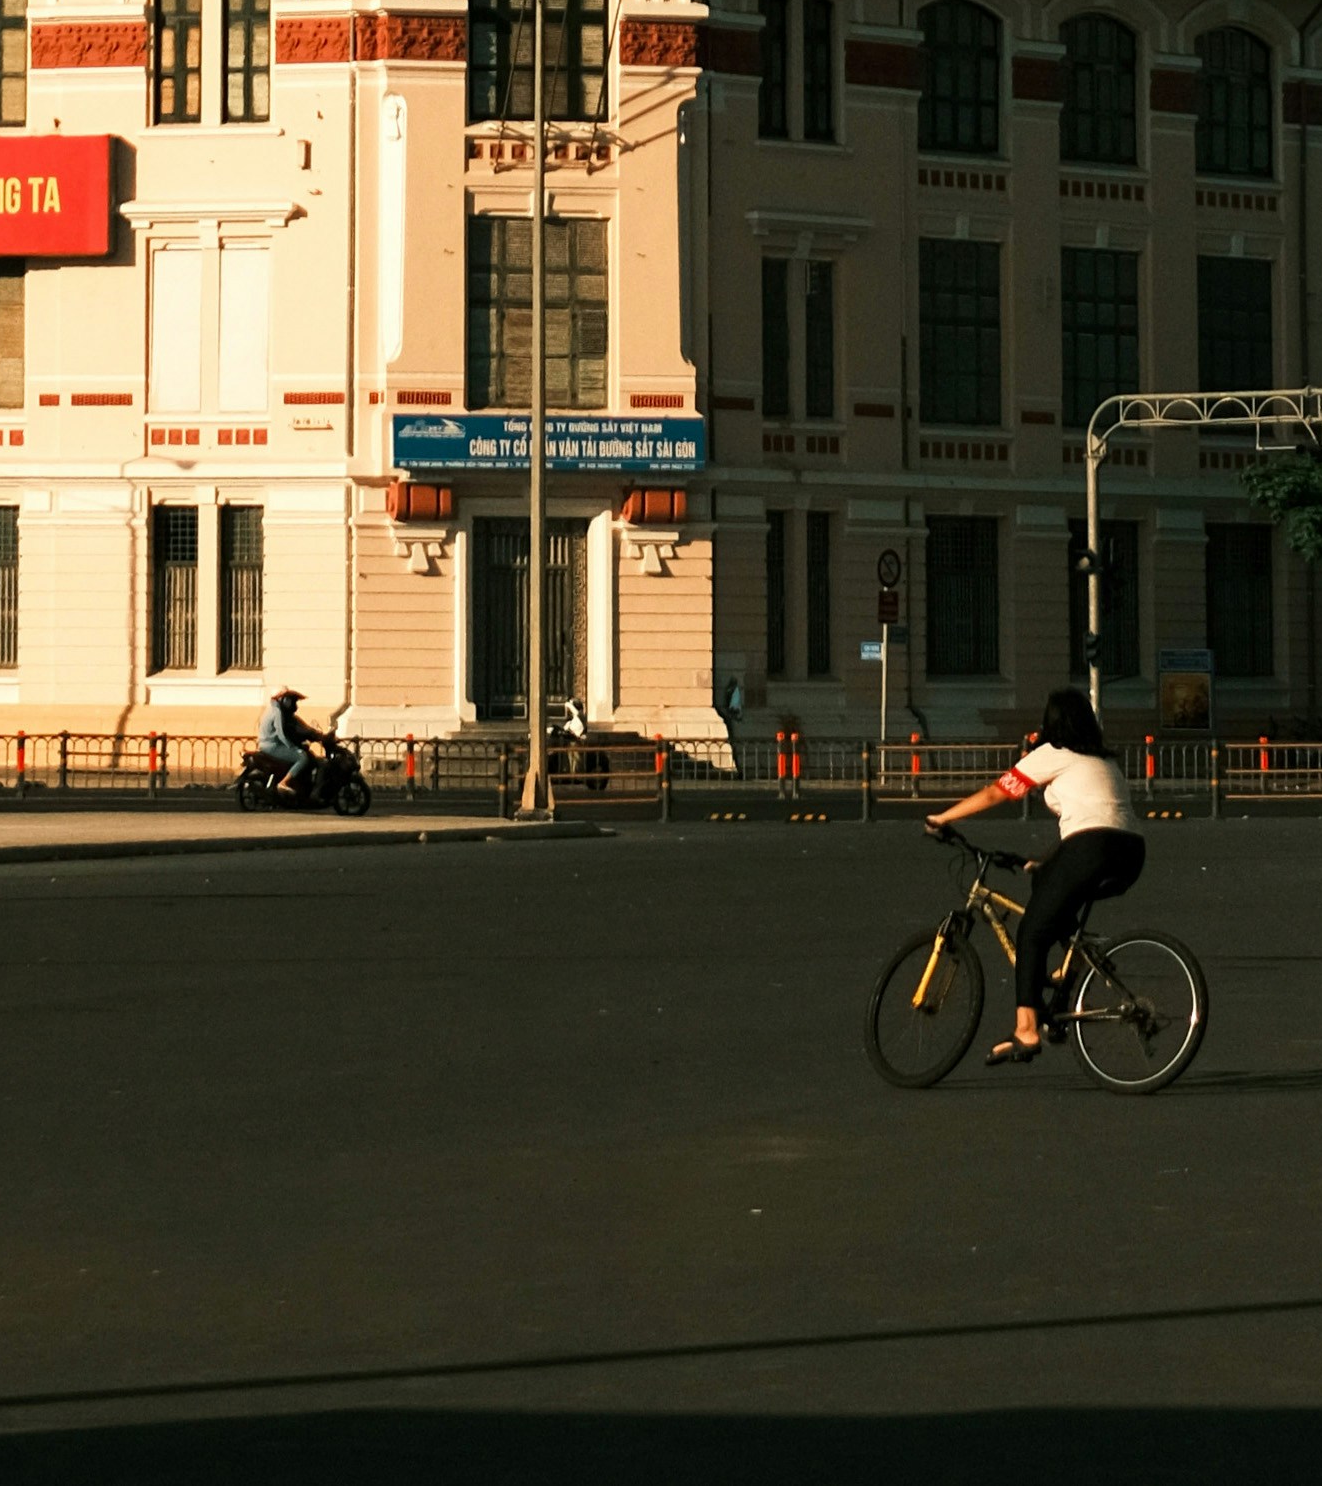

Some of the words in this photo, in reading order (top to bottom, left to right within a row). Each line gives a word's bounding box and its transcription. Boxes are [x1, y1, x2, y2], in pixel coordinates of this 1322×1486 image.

[27, 177, 61, 214] TA
[556, 422, 567, 433] TY
[620, 421, 639, 434] VIỆT
[469, 436, 497, 456] CÔNG
[499, 439, 511, 457] TY
[513, 433, 527, 457] CỔ
[559, 437, 579, 461] VẬN
[581, 435, 597, 458] TẢI
[599, 437, 633, 458] ĐƯỜNG
[635, 435, 654, 458] SẮT
[656, 438, 673, 458] SÀI
[675, 437, 696, 458] GÒN
